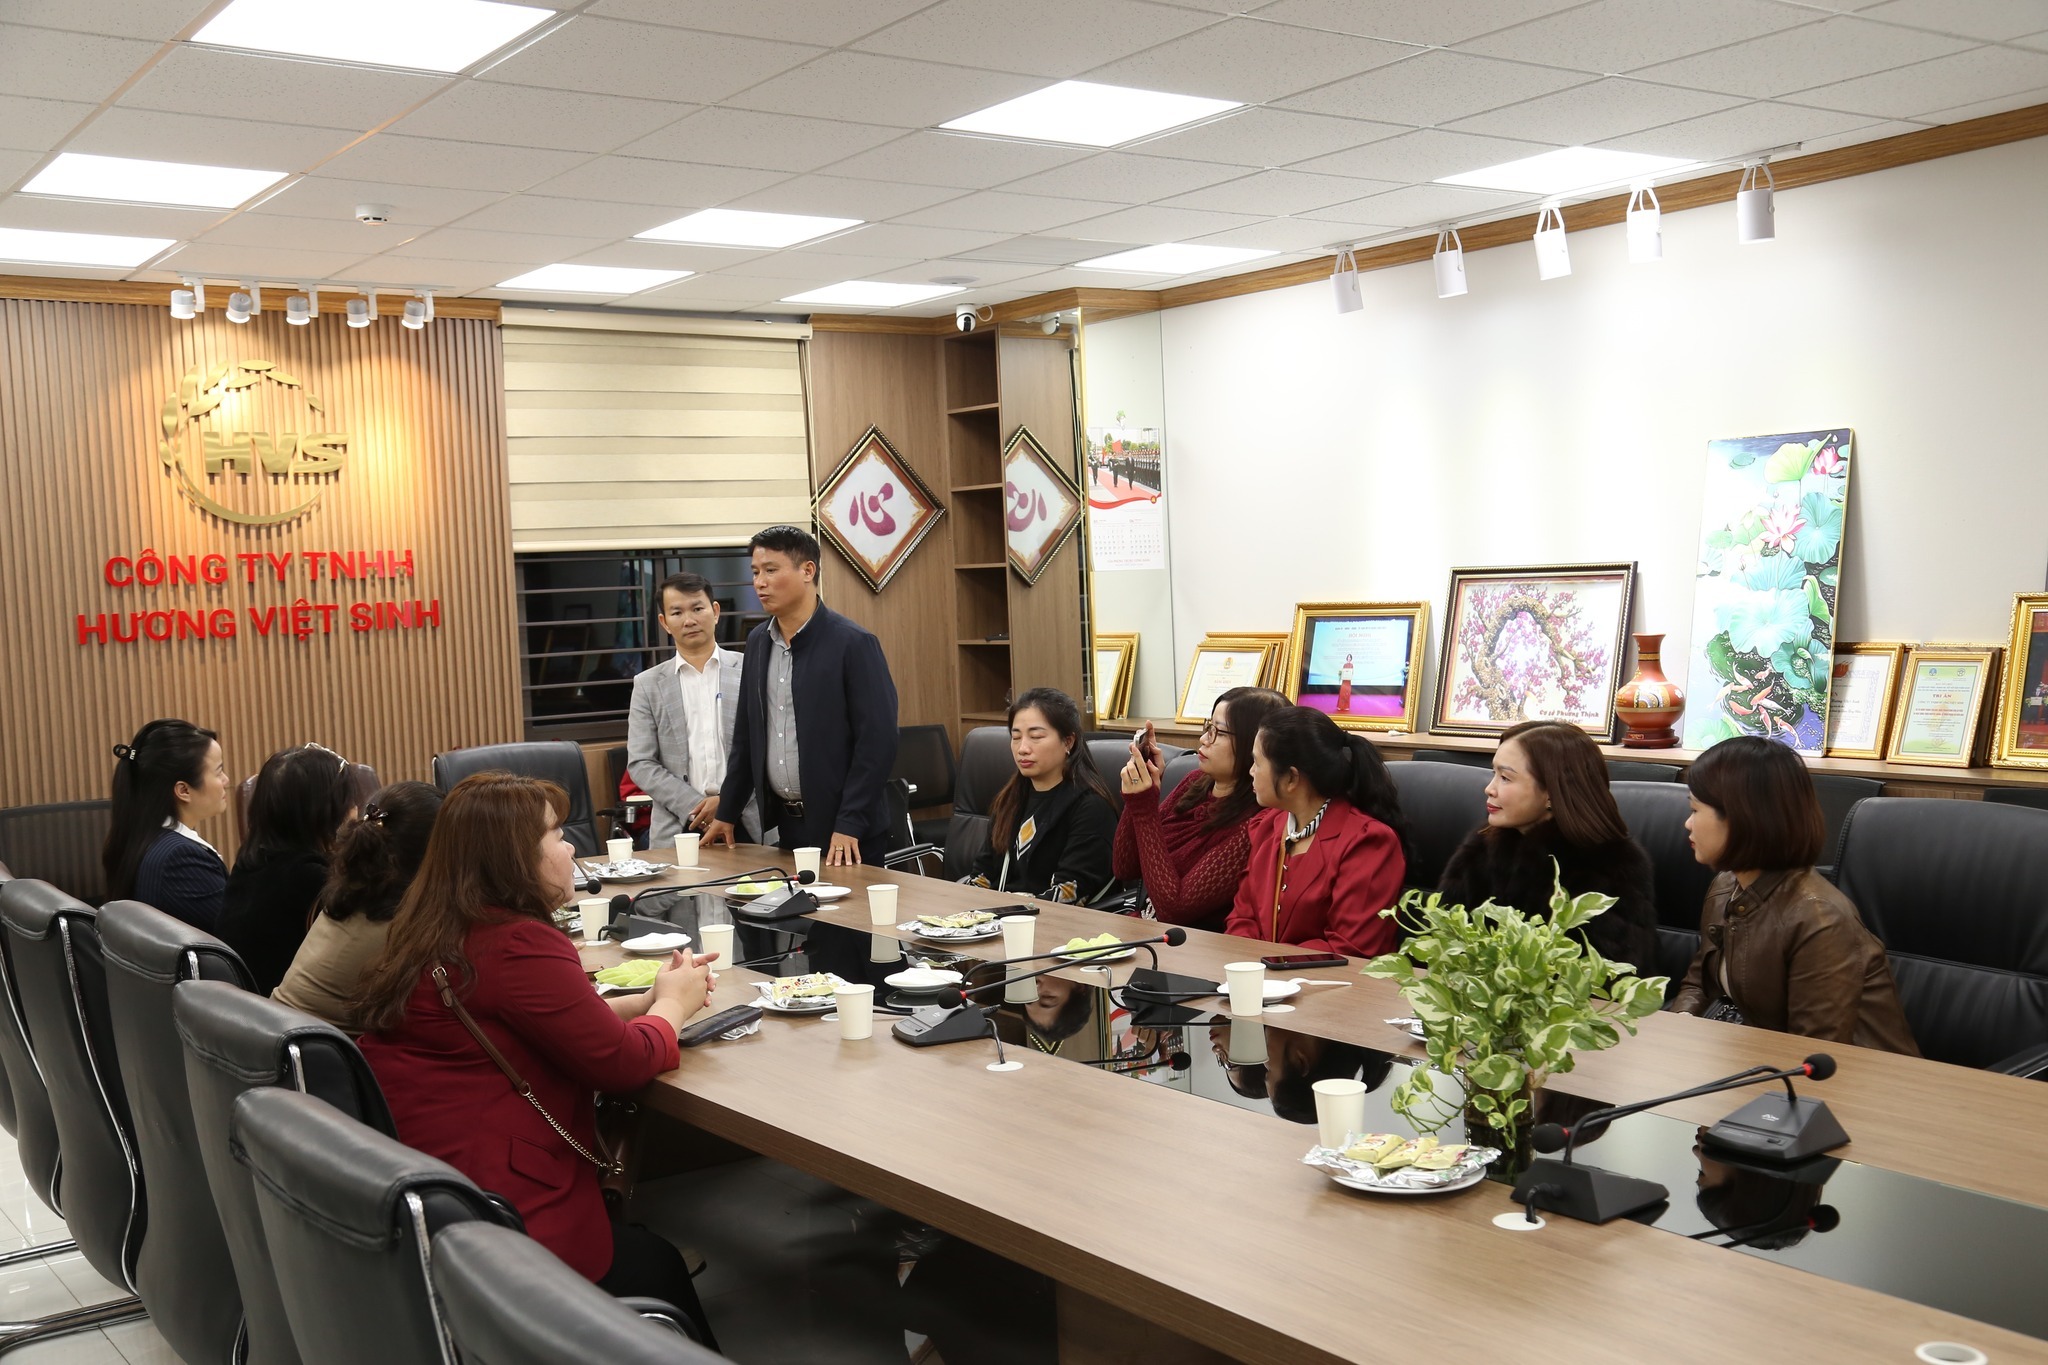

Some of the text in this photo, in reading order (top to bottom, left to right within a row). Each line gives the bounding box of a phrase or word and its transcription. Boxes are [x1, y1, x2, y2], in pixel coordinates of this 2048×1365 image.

[203, 431, 350, 474] HVS
[849, 482, 897, 537] 心
[104, 548, 414, 588] CÔNG TY TNHH
[76, 598, 440, 646] HƯƠNG VIỆT SINH
